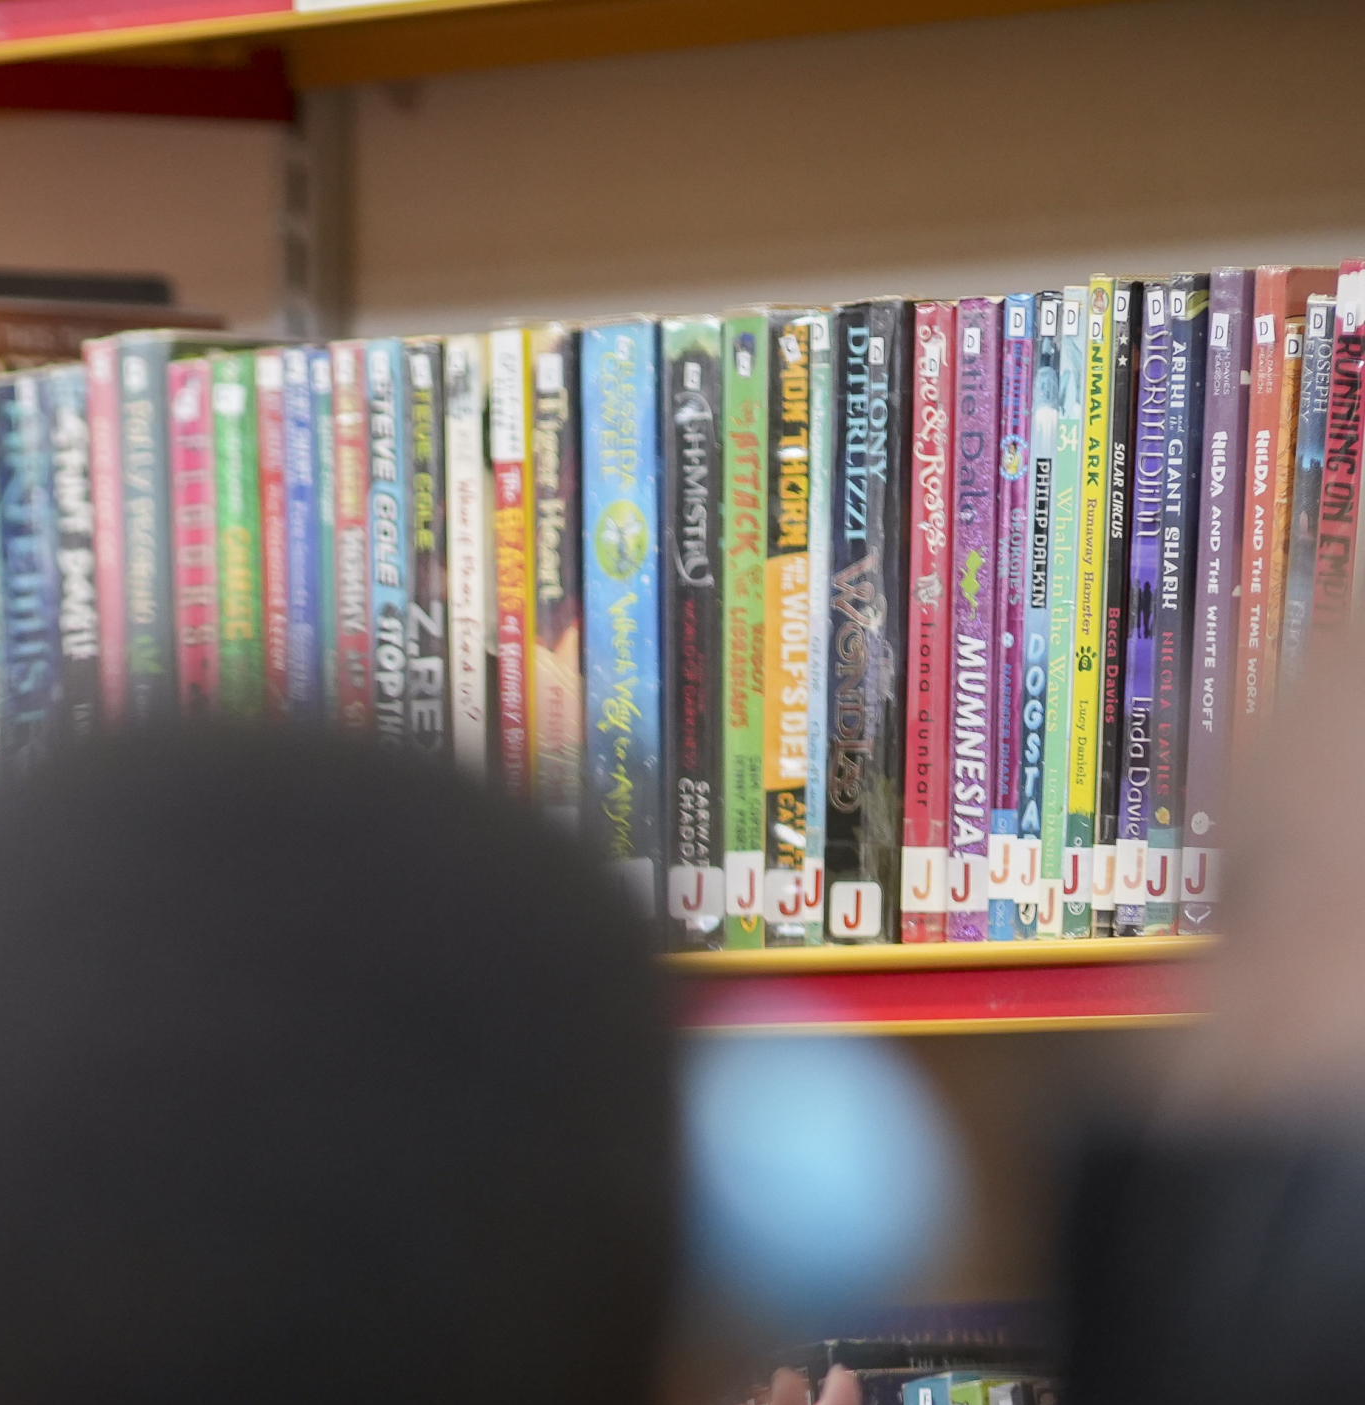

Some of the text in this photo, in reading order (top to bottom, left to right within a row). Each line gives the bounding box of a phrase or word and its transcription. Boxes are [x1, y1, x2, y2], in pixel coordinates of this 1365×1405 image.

[1314, 337, 1334, 413] JOSEPH
[869, 372, 889, 484] TONY
[1058, 424, 1078, 451] 34
[1087, 436, 1100, 487] ARK
[1323, 334, 1365, 522] RUNNING ON
[413, 472, 435, 549] COLE
[532, 387, 569, 604] Tiger Heart
[729, 431, 763, 556] ATTACK
[913, 441, 948, 553] Roses
[959, 431, 987, 525] Dale
[1111, 442, 1126, 540] SOLAR CIRCUS
[374, 493, 399, 587] COLE
[1032, 460, 1050, 608] PHILIP DALKIN
[1162, 438, 1184, 611] GIANT SHARK
[1081, 498, 1098, 636] Runaway Hamster
[1201, 430, 1229, 733] HILDA AND THE WHITE WOFF
[1245, 429, 1272, 715] HILDA AND THE TIME WORM
[779, 590, 810, 708] WOLF'S
[1047, 487, 1074, 733] Whale in the Waves
[374, 616, 406, 699] STOP
[1105, 607, 1121, 724] Becca Davies
[596, 677, 643, 734] Way
[778, 711, 808, 780] DEN
[916, 622, 937, 807] fiona dunbar
[1021, 632, 1047, 840] DOGSTA
[1075, 700, 1090, 786] Lucy Daniels
[1156, 631, 1175, 796] NICOLA DAVIES
[1126, 696, 1153, 840] Linda Davie
[683, 872, 704, 912] J
[737, 869, 756, 910] J
[779, 877, 802, 916] J
[805, 869, 822, 908] J
[913, 860, 932, 900] J
[951, 863, 971, 902] J
[990, 843, 1010, 884] J
[1021, 848, 1037, 886] J
[1063, 854, 1079, 895] J
[1093, 856, 1116, 896] J
[1123, 849, 1144, 889] J
[1146, 855, 1167, 896] J
[1185, 853, 1207, 895] J
[843, 889, 862, 929] J
[1038, 888, 1055, 925] J
